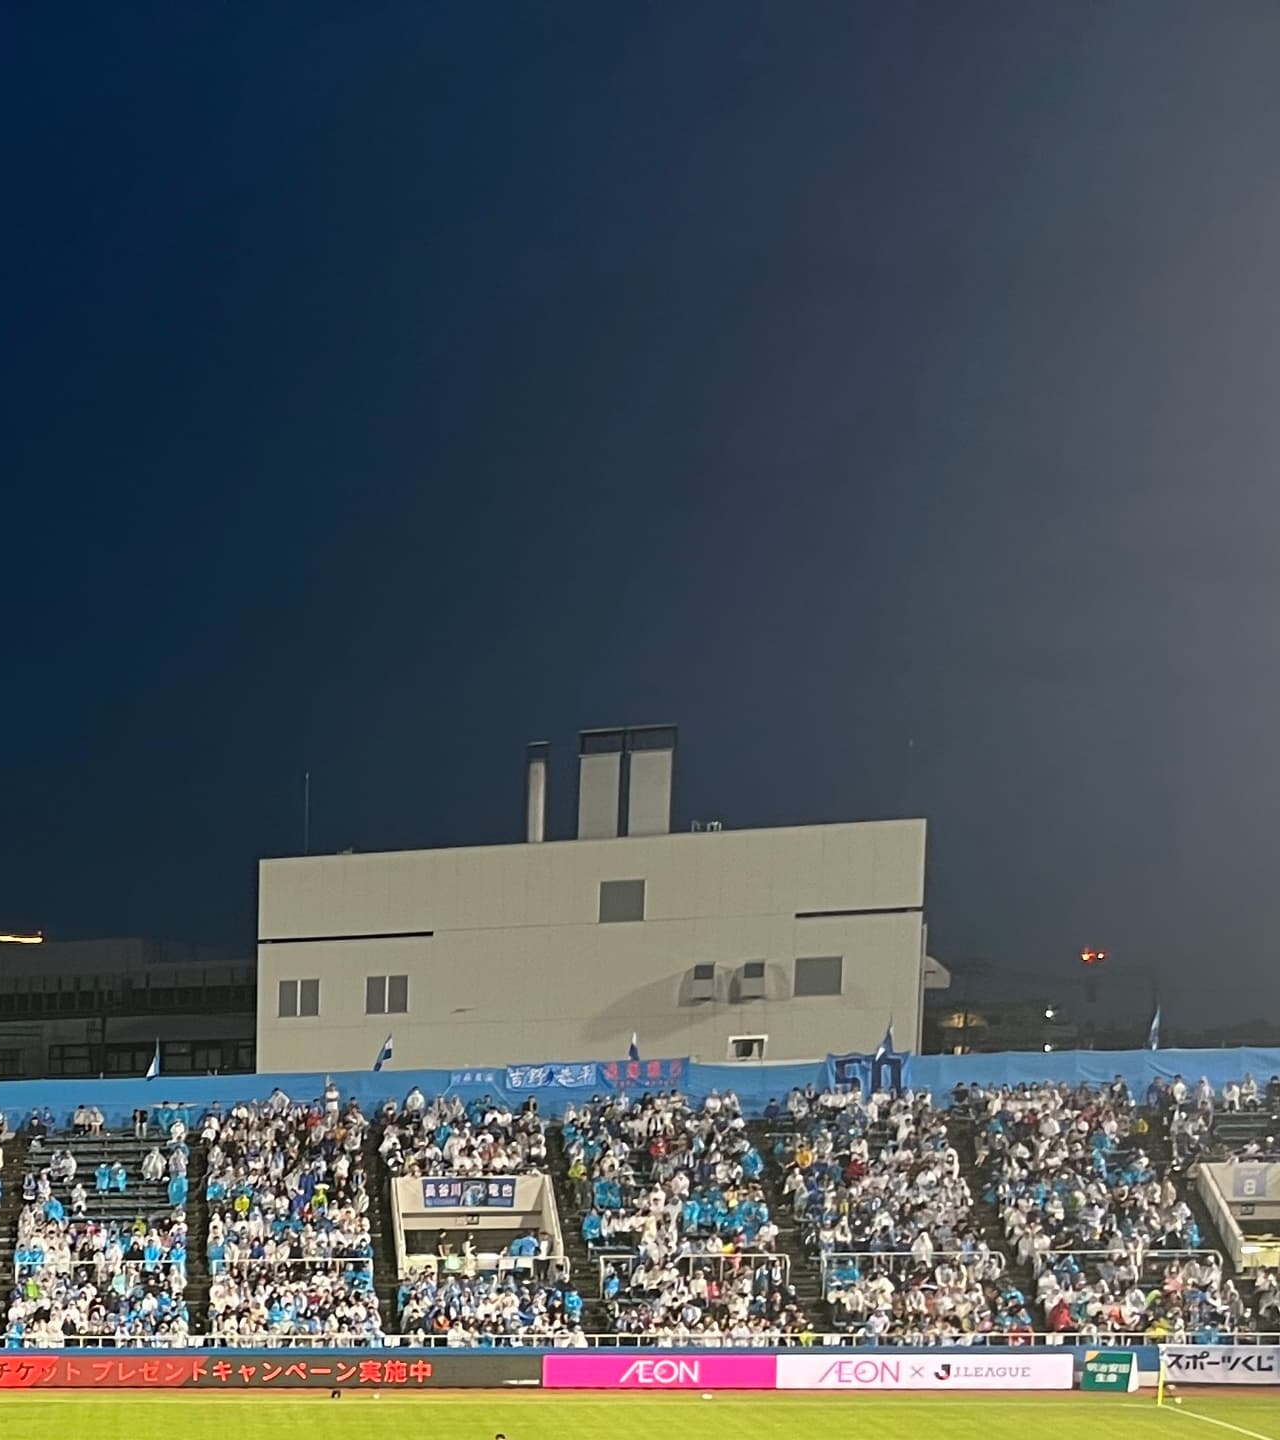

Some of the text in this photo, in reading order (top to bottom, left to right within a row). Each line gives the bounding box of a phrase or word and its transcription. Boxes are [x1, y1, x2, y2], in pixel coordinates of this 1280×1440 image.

[1167, 1350, 1274, 1372] スポーツくじ
